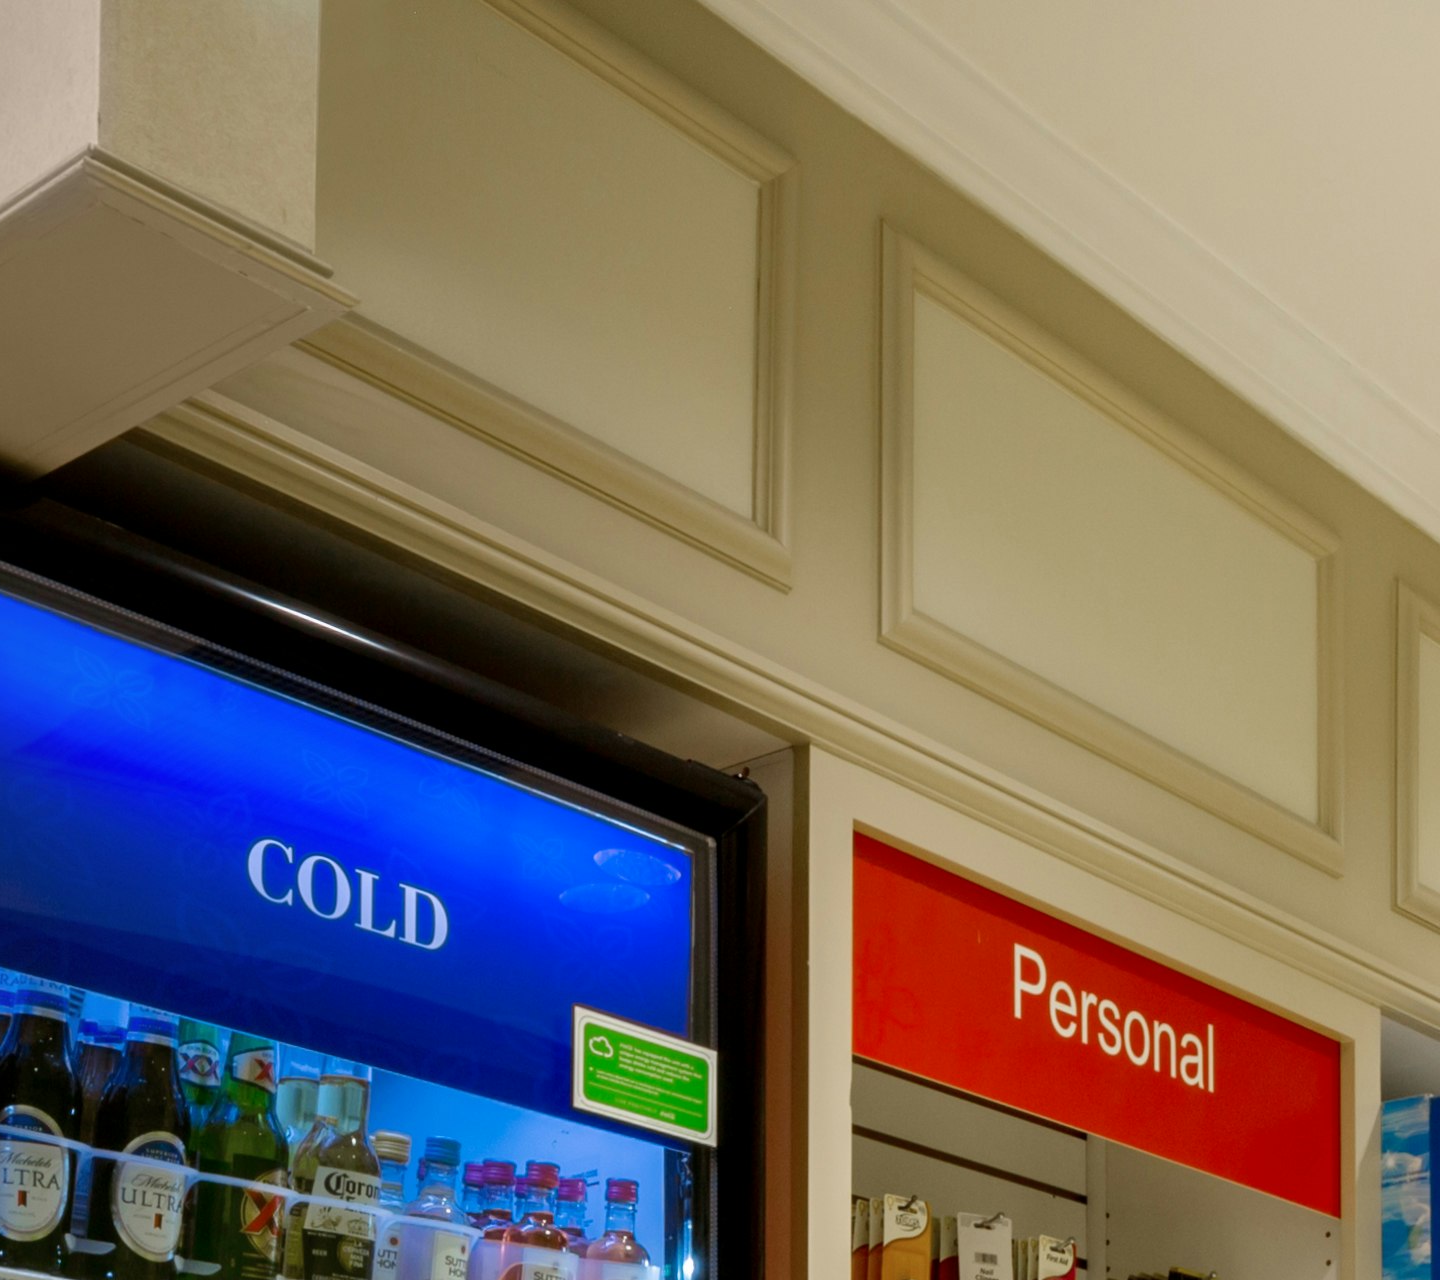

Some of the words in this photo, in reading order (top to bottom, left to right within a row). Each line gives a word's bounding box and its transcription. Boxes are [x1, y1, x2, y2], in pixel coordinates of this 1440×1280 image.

[246, 838, 448, 951] COLD
[1013, 943, 1214, 1092] Personal
[324, 1170, 380, 1199] Coron
[980, 1268, 994, 1277] Nail
